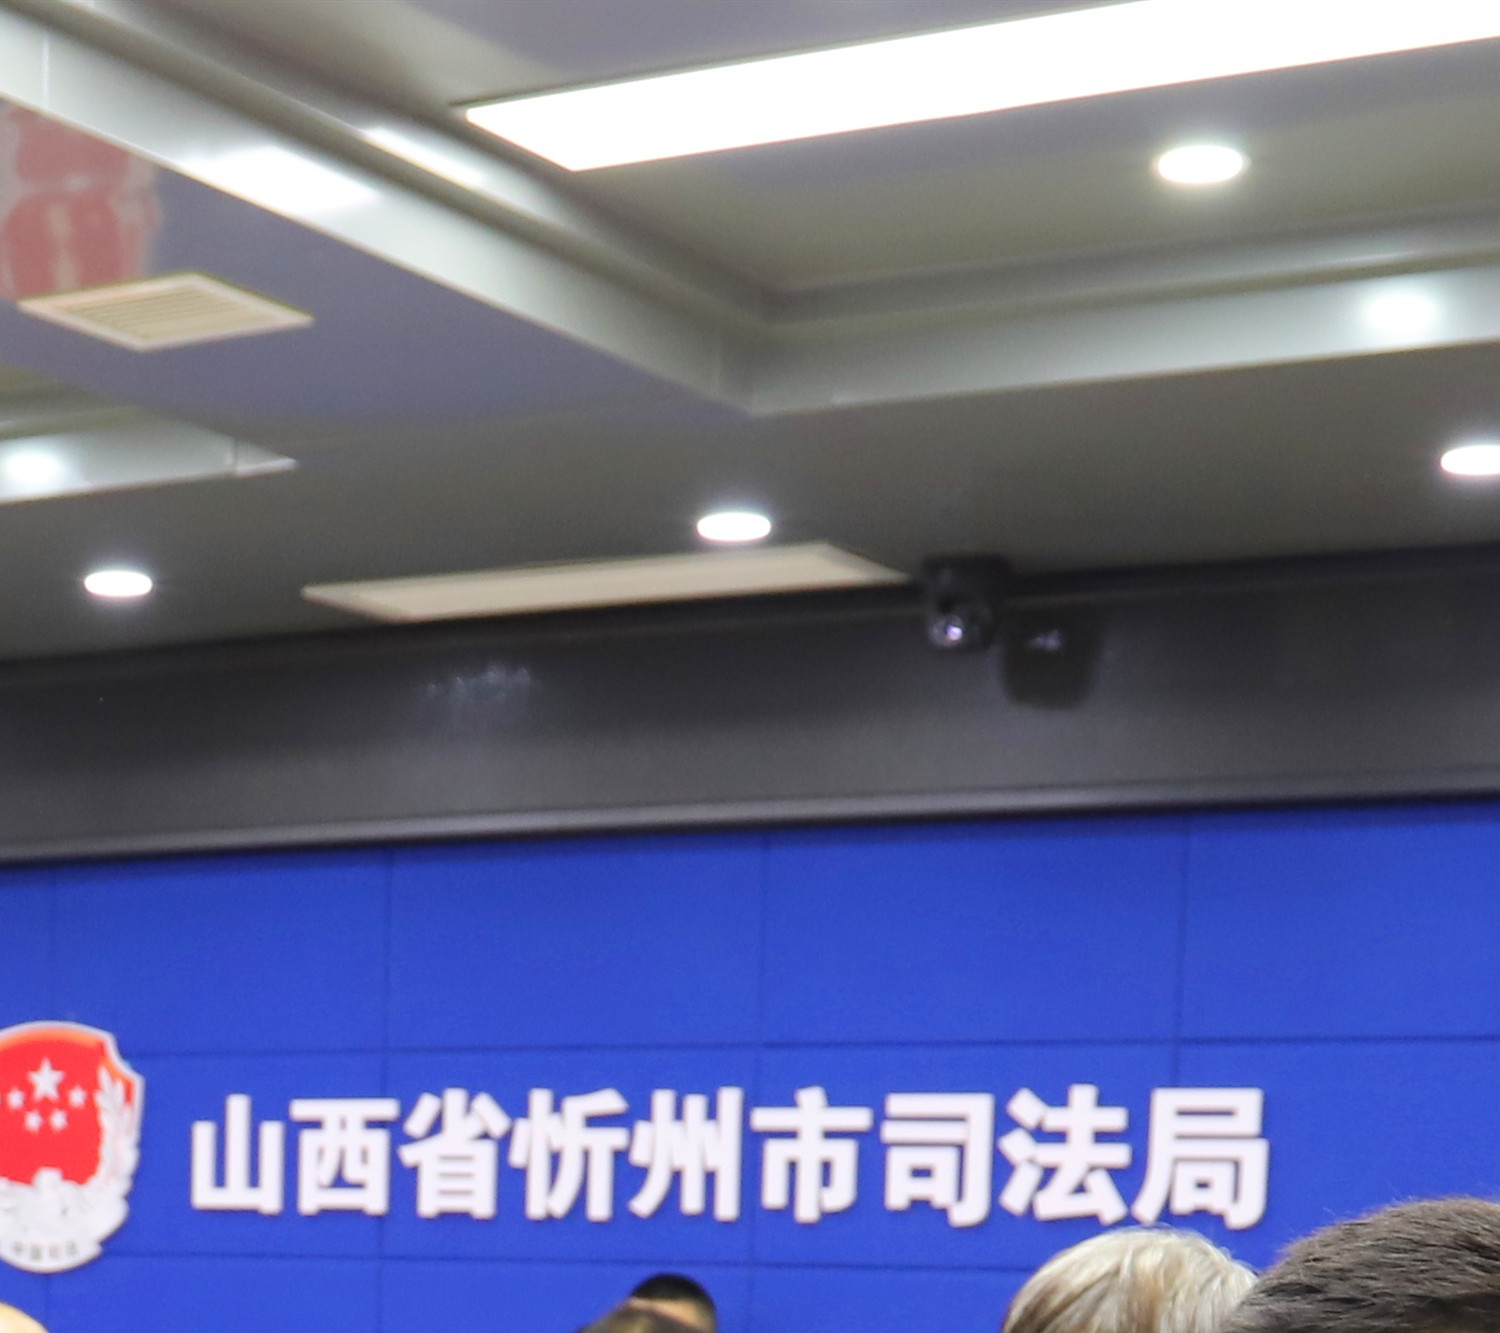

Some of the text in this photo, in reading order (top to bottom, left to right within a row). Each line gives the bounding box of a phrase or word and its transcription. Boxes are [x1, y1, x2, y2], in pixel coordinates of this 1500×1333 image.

[189, 1084, 1270, 1228] 山西省忻州市司法局
